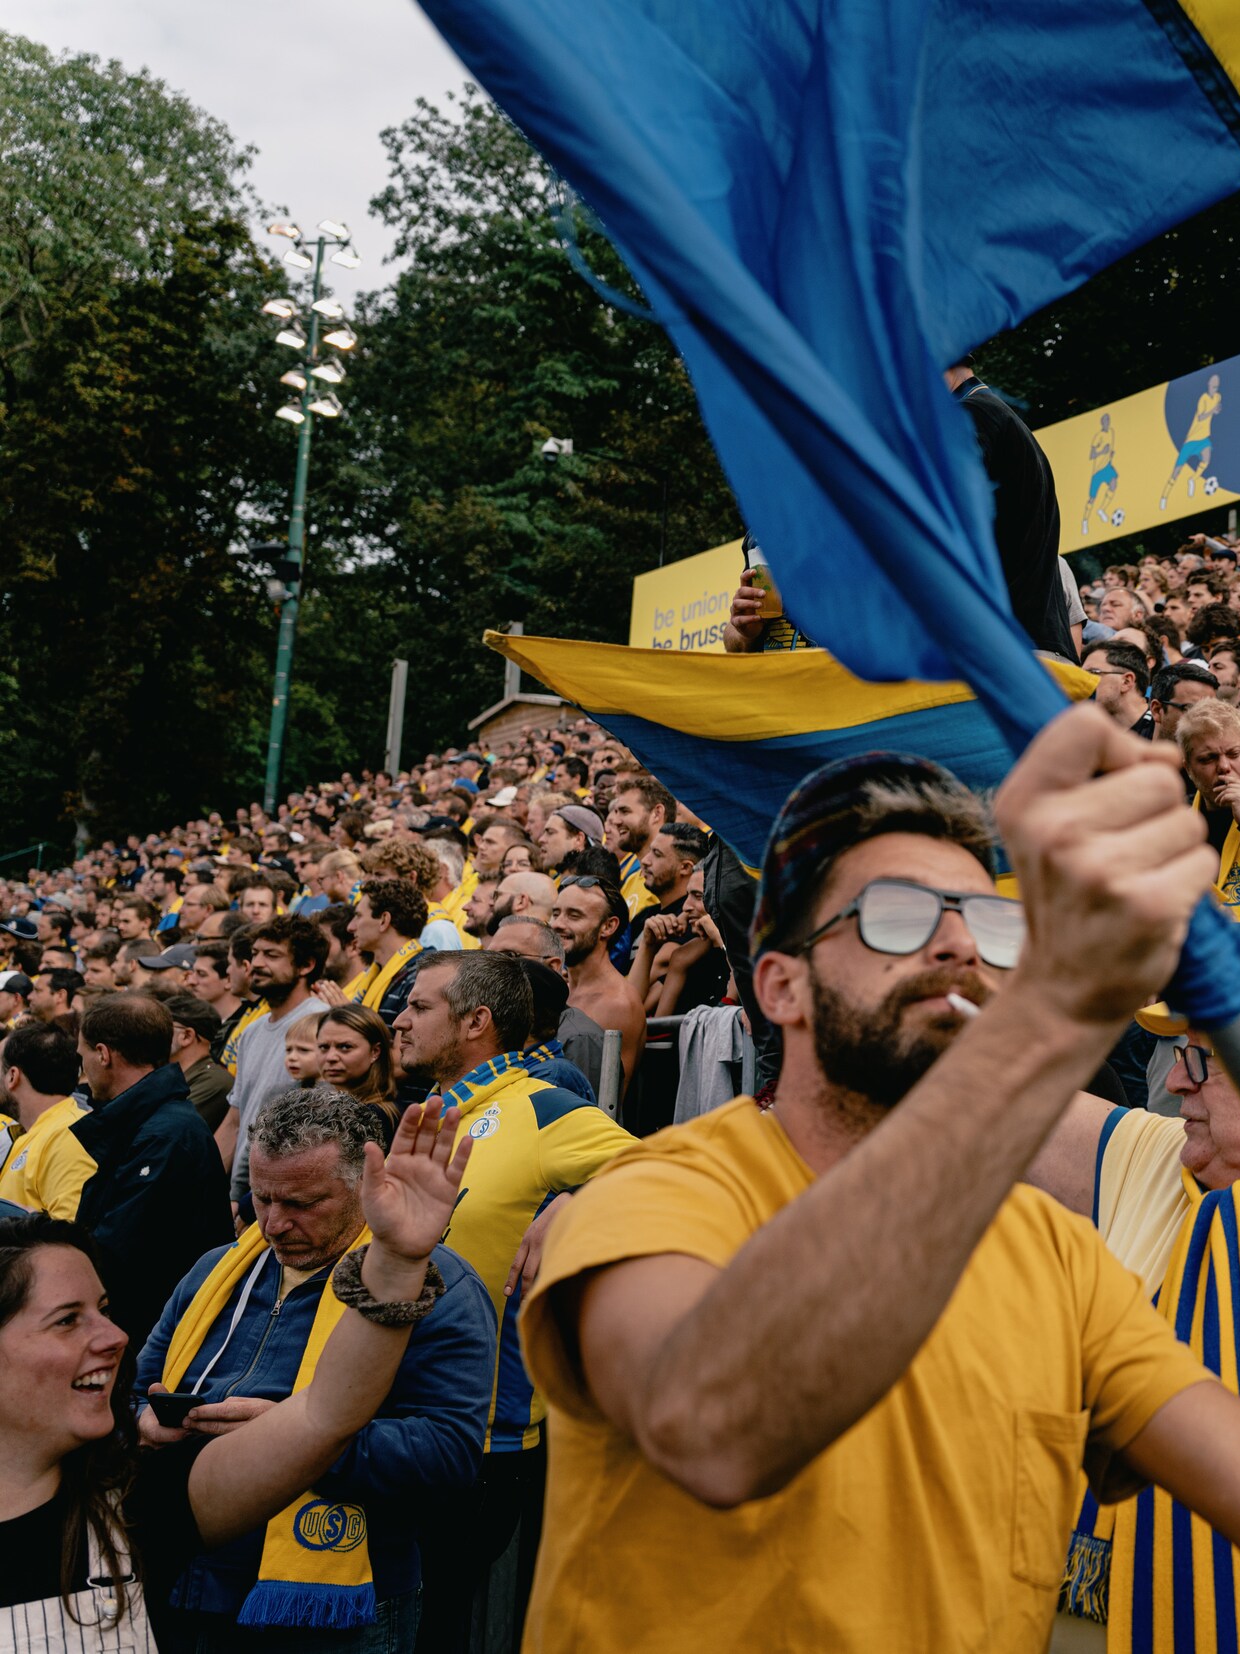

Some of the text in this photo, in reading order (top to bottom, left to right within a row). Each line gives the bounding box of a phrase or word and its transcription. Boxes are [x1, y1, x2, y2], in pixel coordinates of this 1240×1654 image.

[653, 591, 729, 632] be union
[303, 1511, 361, 1541] USG
